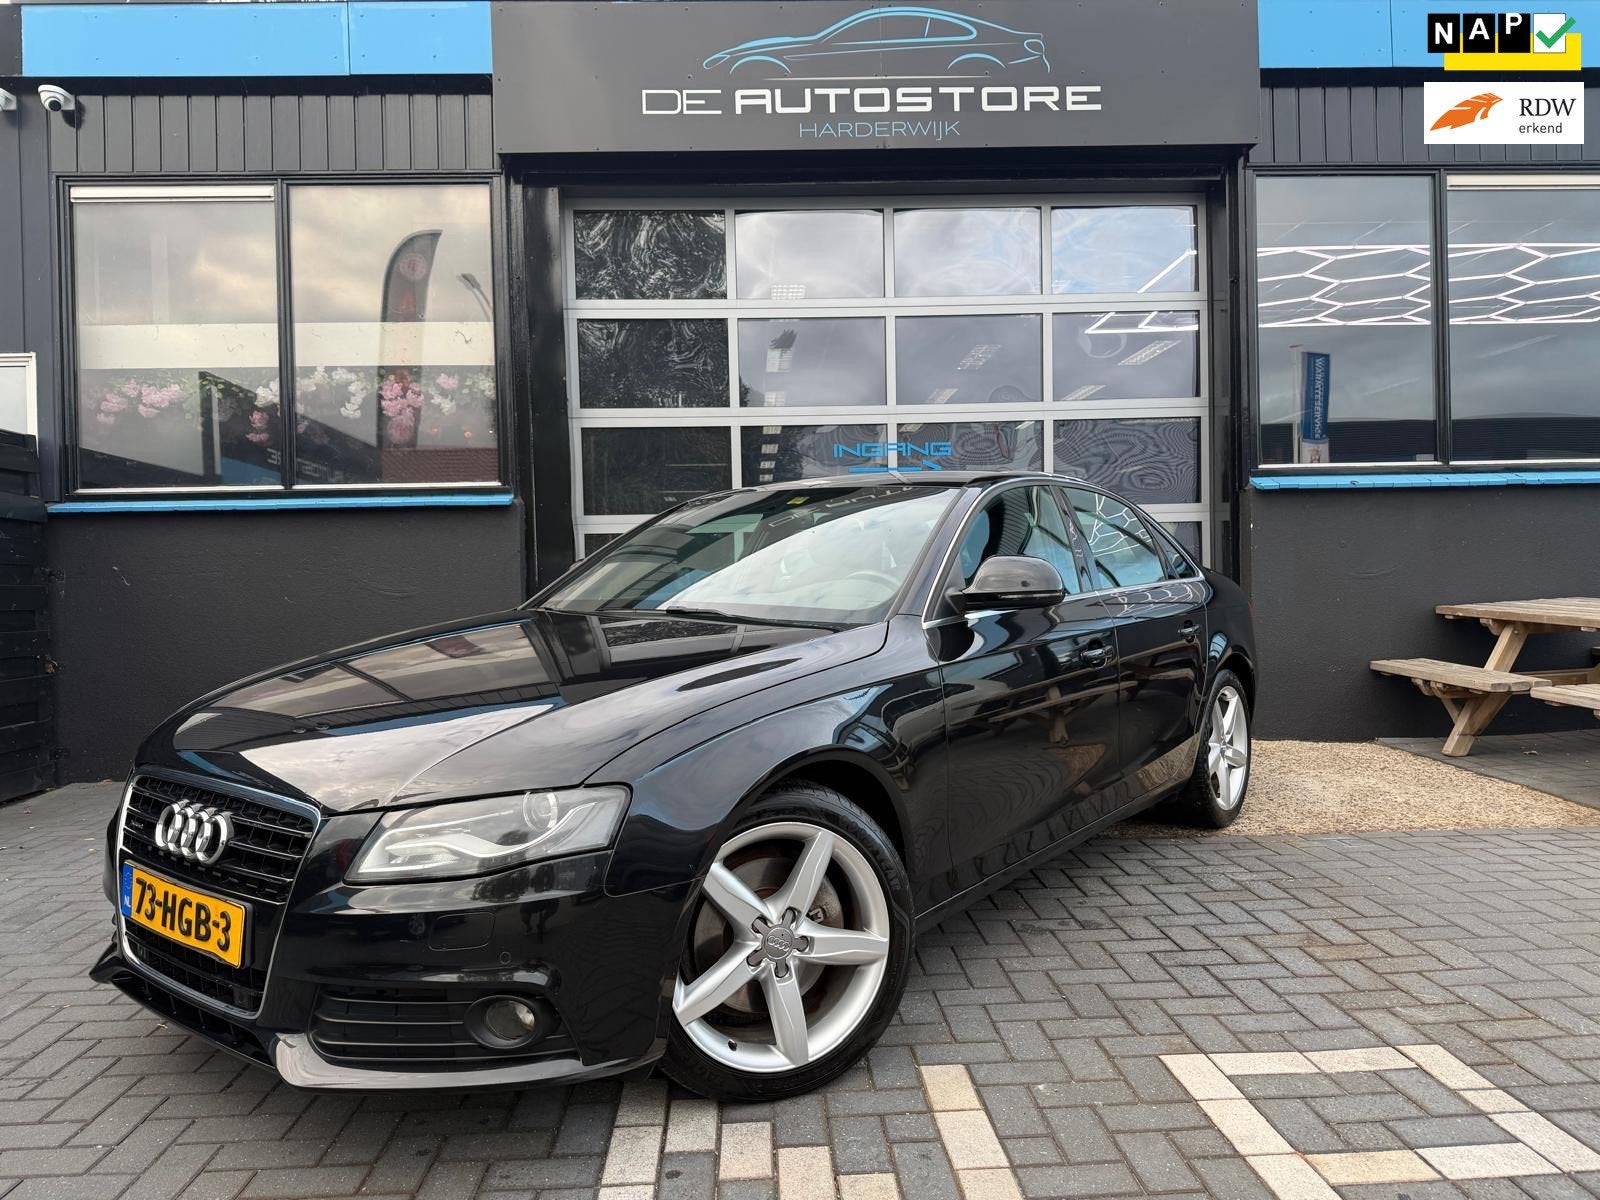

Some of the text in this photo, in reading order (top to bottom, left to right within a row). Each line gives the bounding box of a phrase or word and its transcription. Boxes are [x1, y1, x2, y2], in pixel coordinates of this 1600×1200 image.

[641, 85, 1102, 115] DE AUTOSTORE
[799, 120, 961, 141] HARDERWIJK
[833, 442, 952, 458] INGANG
[123, 894, 132, 908] NL
[136, 877, 231, 951] 73-HGB-3
